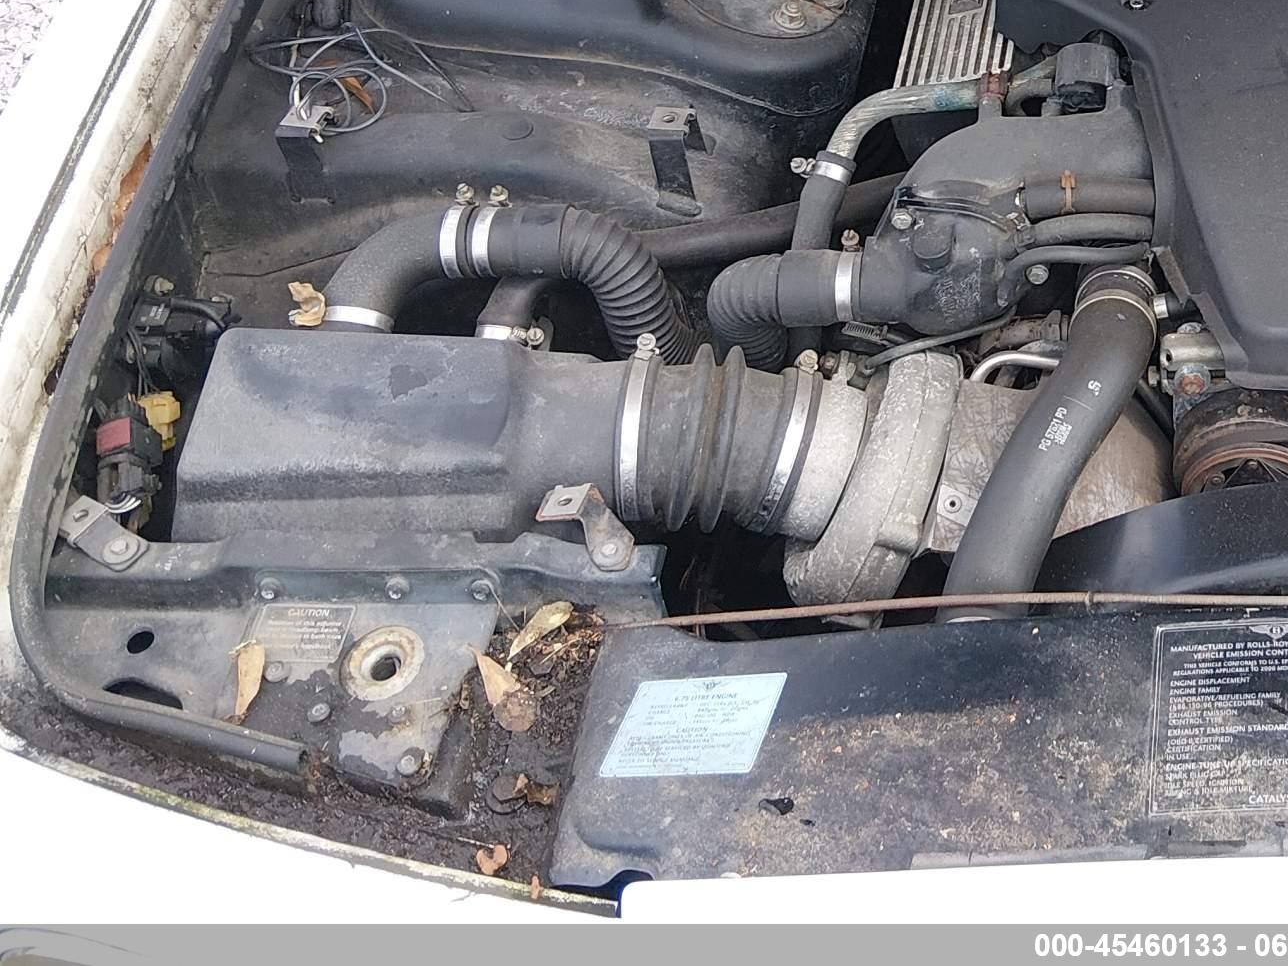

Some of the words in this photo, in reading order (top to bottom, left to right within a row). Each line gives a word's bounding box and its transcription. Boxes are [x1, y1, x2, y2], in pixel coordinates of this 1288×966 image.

[288, 608, 330, 617] CAUTION
[1170, 642, 1233, 652] MANUFACTURED
[1198, 677, 1250, 685] DISPLACEMENT
[1169, 693, 1256, 704] EVAPORATIVE/REFUELING
[1168, 728, 1204, 736] EXHAUST
[1167, 744, 1221, 753] CERTIFICATION
[1166, 762, 1197, 771] ENGINE
